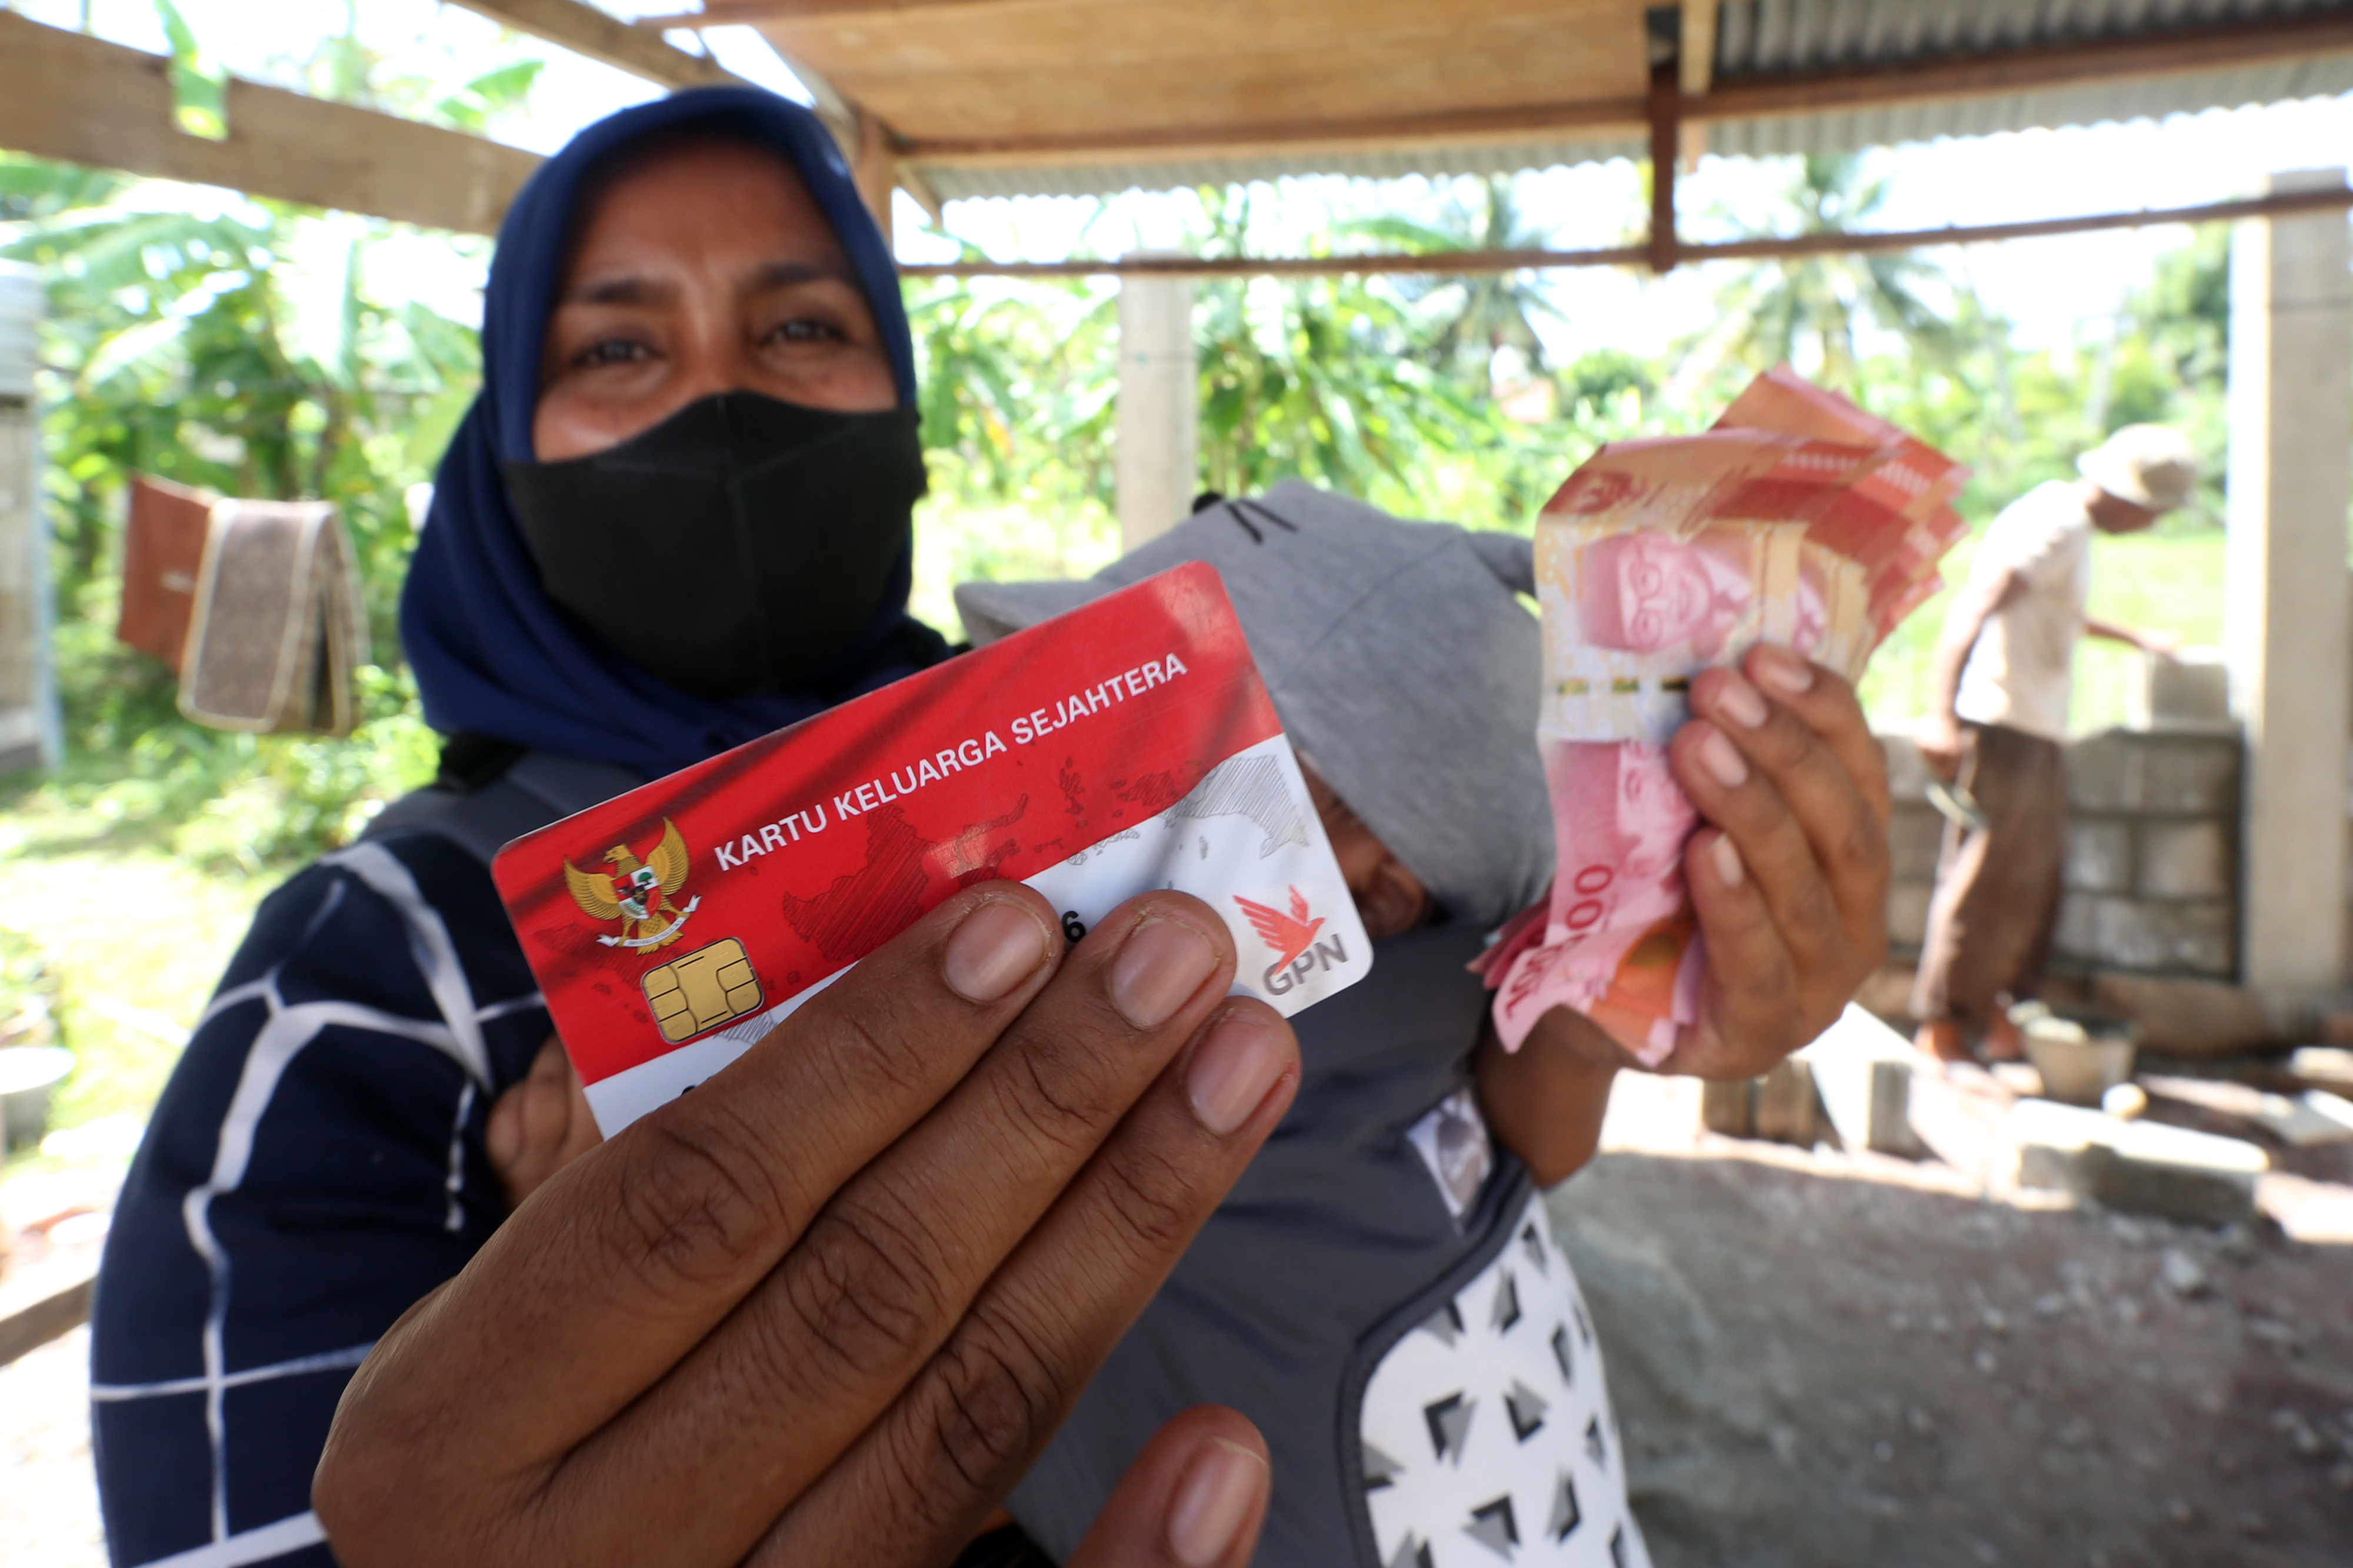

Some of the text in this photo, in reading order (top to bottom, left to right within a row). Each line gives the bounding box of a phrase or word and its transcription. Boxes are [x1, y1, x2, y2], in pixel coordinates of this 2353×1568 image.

[714, 652, 1188, 872] KARTU KELUARGA SEJAHTERA
[1263, 933, 1348, 996] GPN
